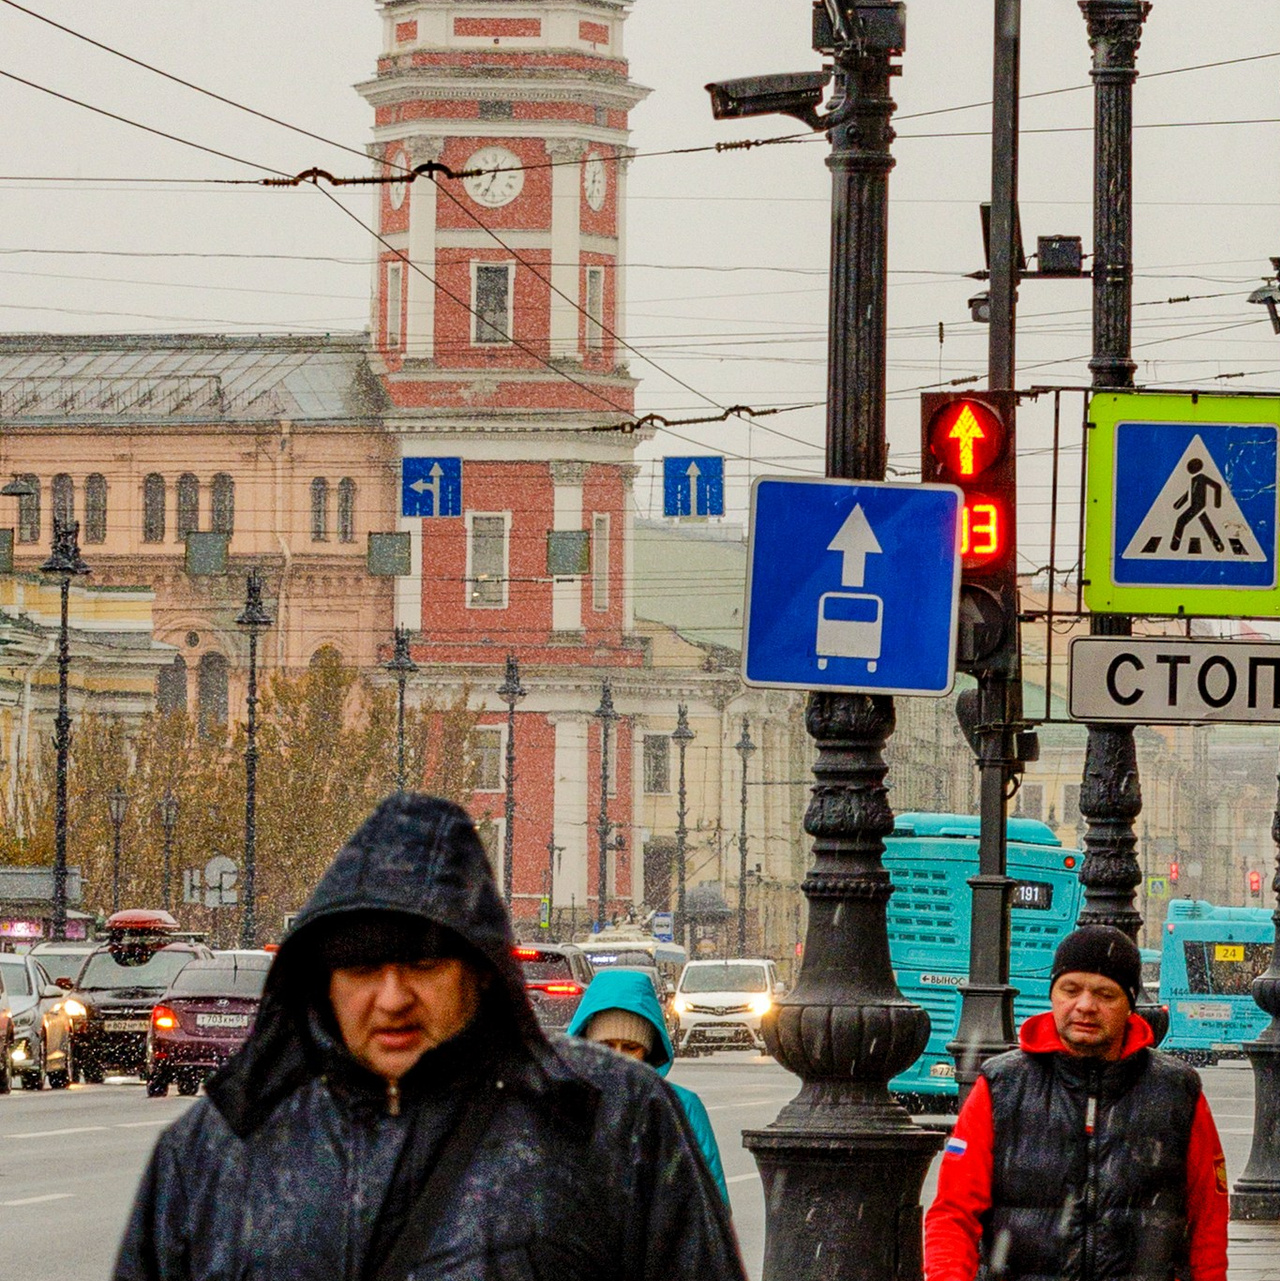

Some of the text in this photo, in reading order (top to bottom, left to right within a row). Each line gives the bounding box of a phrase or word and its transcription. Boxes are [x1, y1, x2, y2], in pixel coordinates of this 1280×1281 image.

[961, 504, 997, 554] 3
[1020, 886, 1039, 901] 191
[1222, 948, 1237, 958] 24
[931, 975, 966, 986] ВЫНОС
